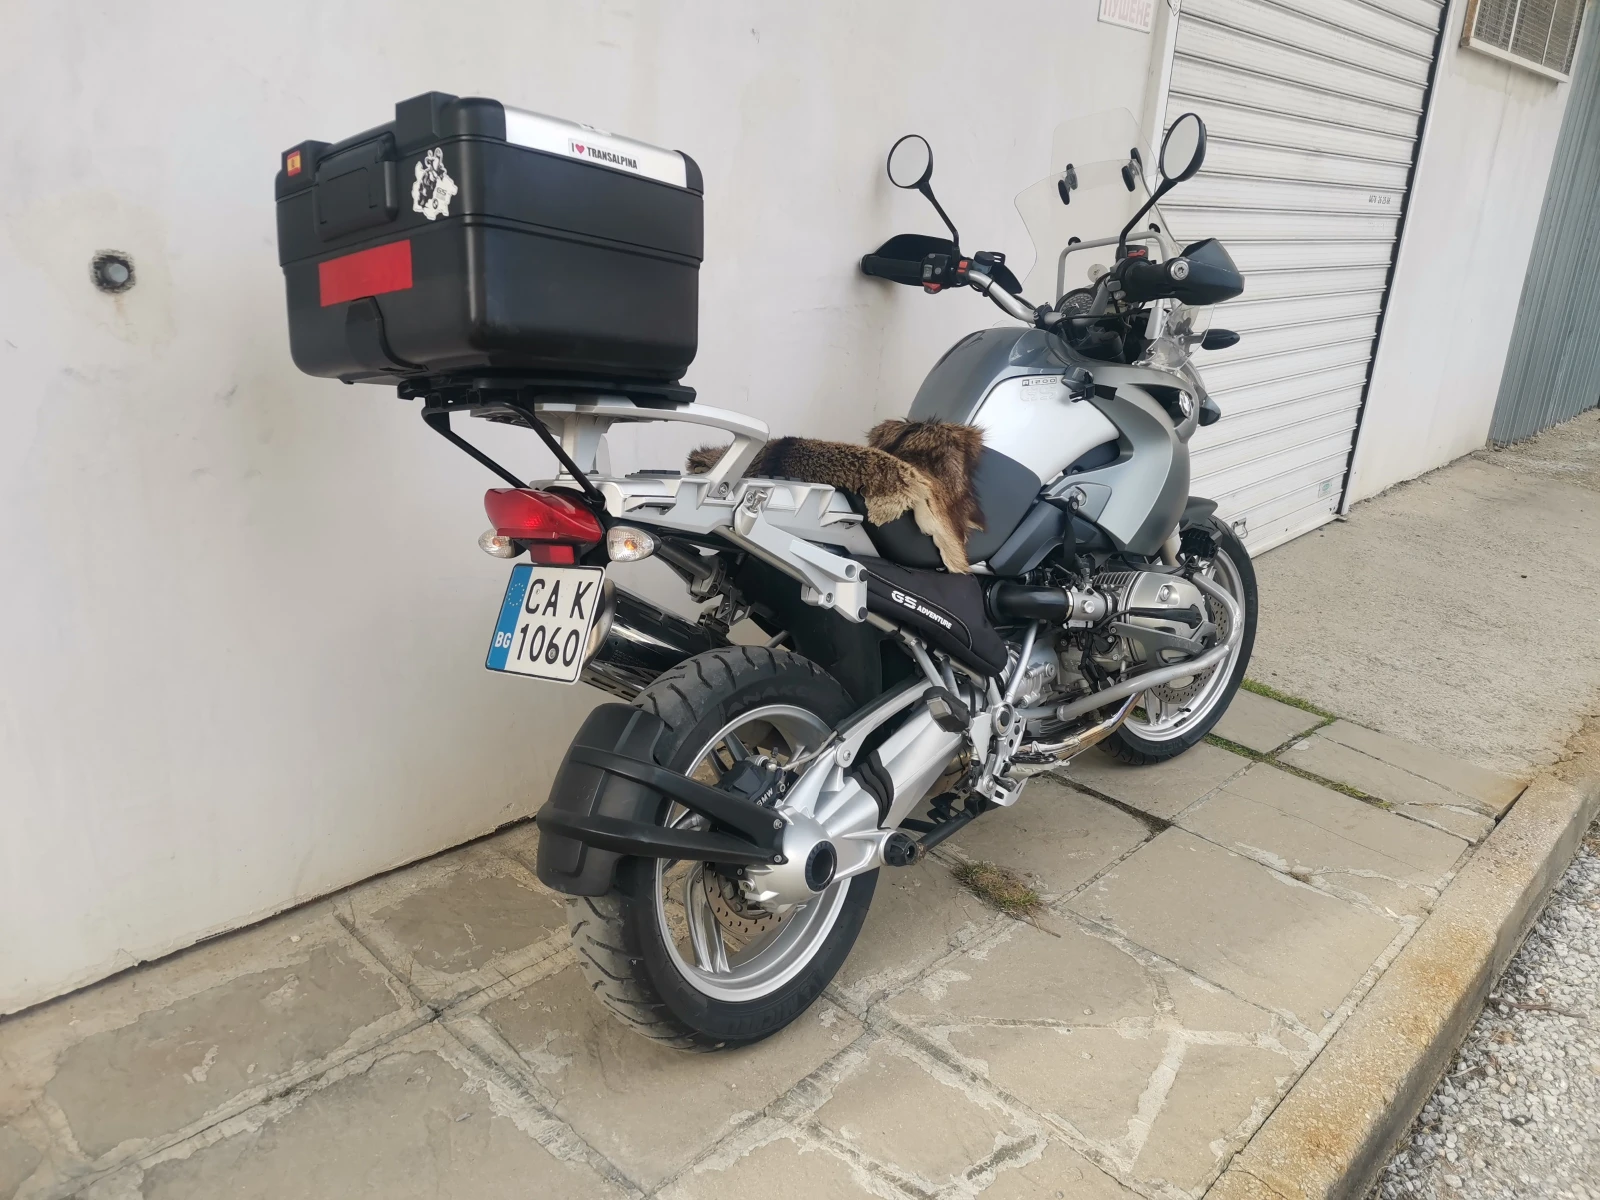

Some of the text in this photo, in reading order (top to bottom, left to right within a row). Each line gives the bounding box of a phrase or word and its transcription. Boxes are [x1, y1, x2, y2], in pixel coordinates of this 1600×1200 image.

[571, 142, 638, 169] I TRANSALPINA
[525, 578, 594, 620] CA K
[891, 590, 953, 630] GS ADVENTURE
[494, 631, 512, 648] BG
[517, 623, 580, 667] 1060
